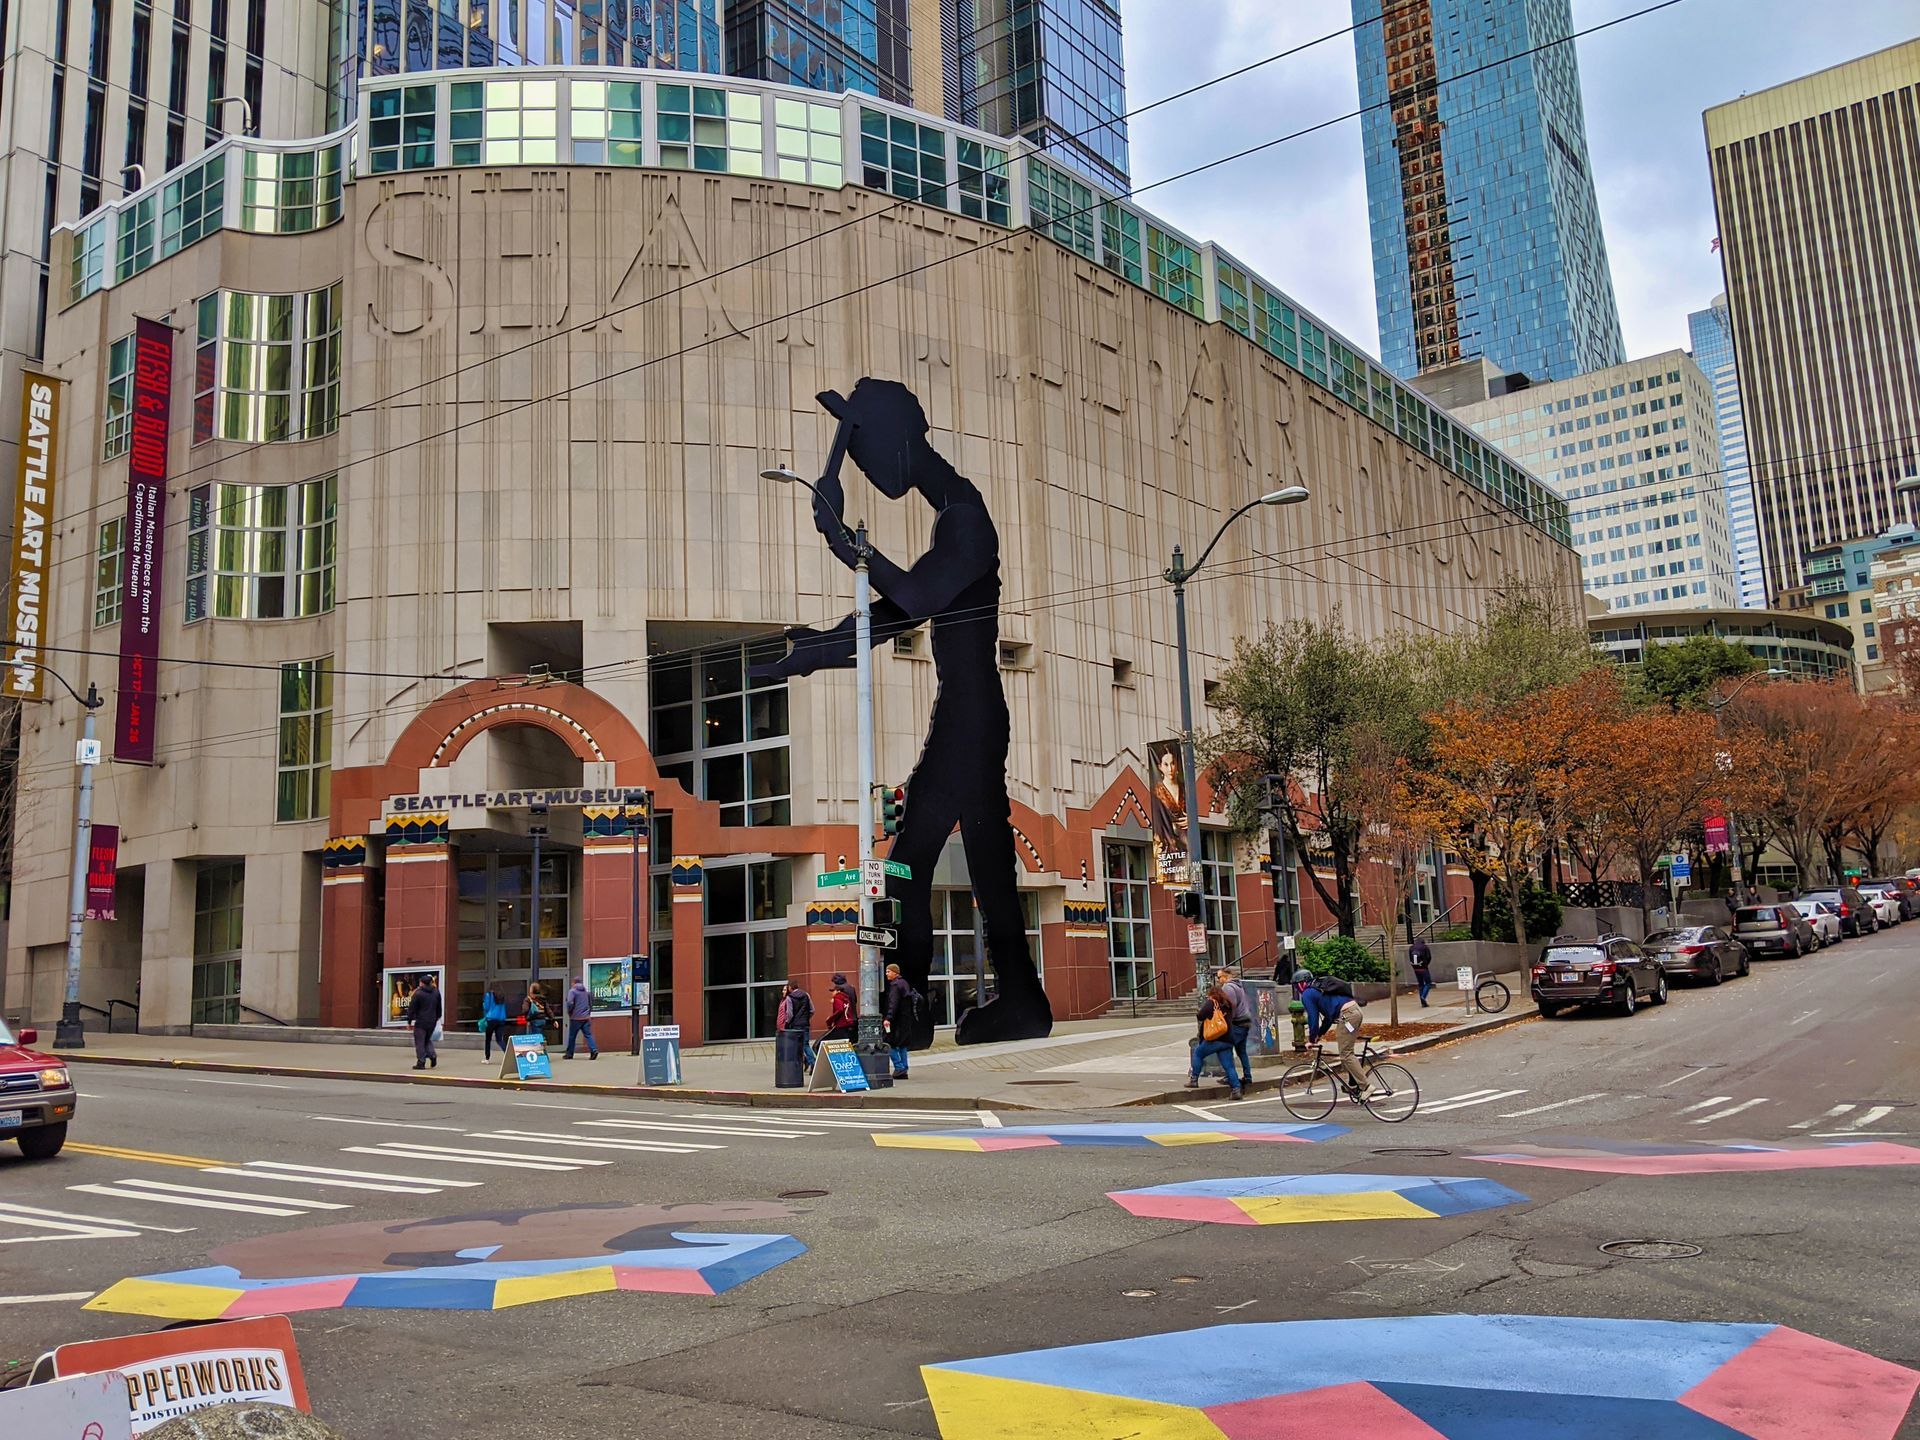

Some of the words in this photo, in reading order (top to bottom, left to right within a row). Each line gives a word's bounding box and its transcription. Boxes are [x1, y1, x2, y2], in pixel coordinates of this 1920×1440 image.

[137, 336, 170, 395] FLESH
[139, 394, 165, 412] &
[24, 382, 52, 505] SEATTLE
[132, 412, 167, 477] BLOOD
[147, 486, 158, 518] Italian
[133, 482, 146, 552] Capodimonte
[20, 506, 46, 568] ART
[143, 520, 155, 588] Masterpieces
[130, 556, 142, 598] Museum
[142, 589, 153, 616] from
[13, 571, 41, 692] MUSEUM
[141, 616, 152, 634] the
[131, 653, 143, 676] OCT
[130, 703, 142, 727] JAN
[393, 793, 488, 811] SEATTLE
[493, 791, 538, 807] ART
[868, 862, 880, 871] NO
[1158, 851, 1187, 861] SEATTLE
[1158, 860, 1173, 868] ART
[844, 873, 856, 881] Ave
[1158, 865, 1187, 875] MUSEUM
[860, 931, 872, 940] ONE
[873, 933, 885, 941] WAY
[127, 1356, 284, 1412] PPERWORKS
